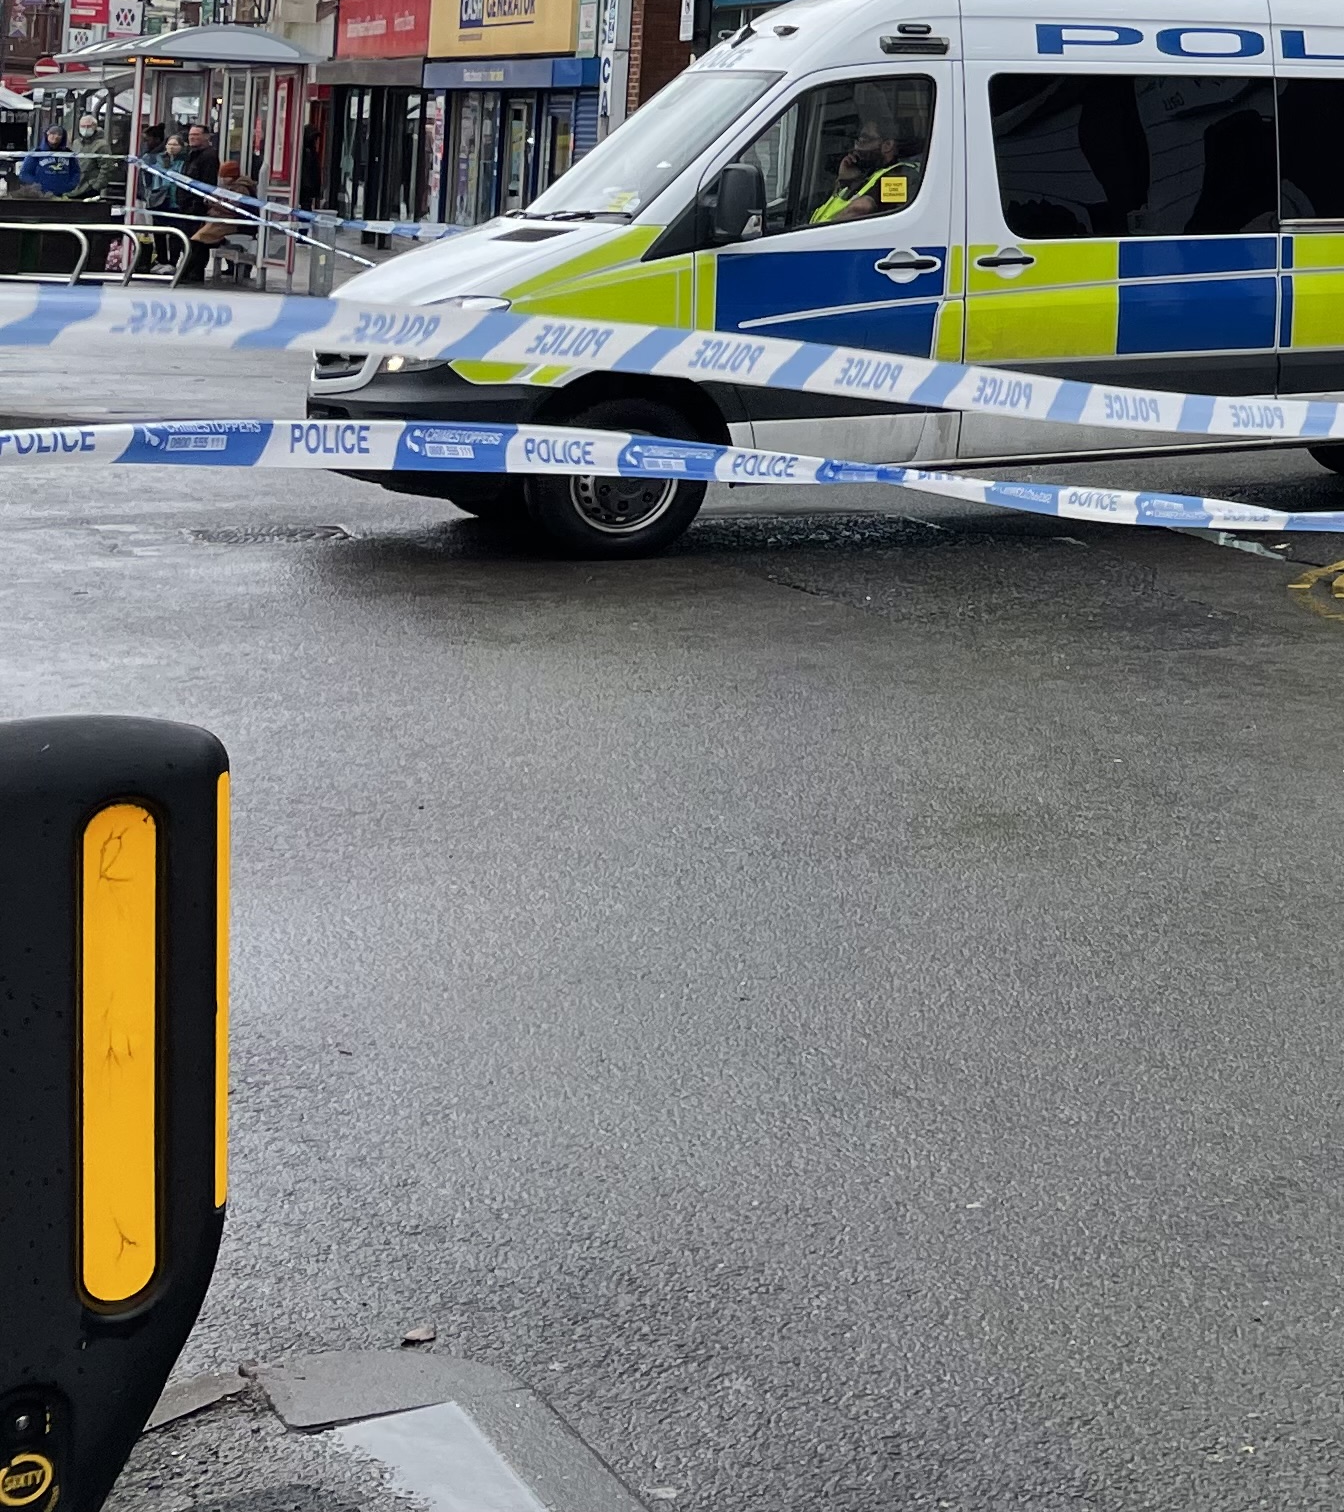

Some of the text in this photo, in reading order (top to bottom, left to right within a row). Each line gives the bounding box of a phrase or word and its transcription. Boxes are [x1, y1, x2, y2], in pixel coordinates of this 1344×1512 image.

[290, 423, 371, 455] POLICE
[524, 437, 595, 466] POLICE
[732, 453, 799, 478] POLICE
